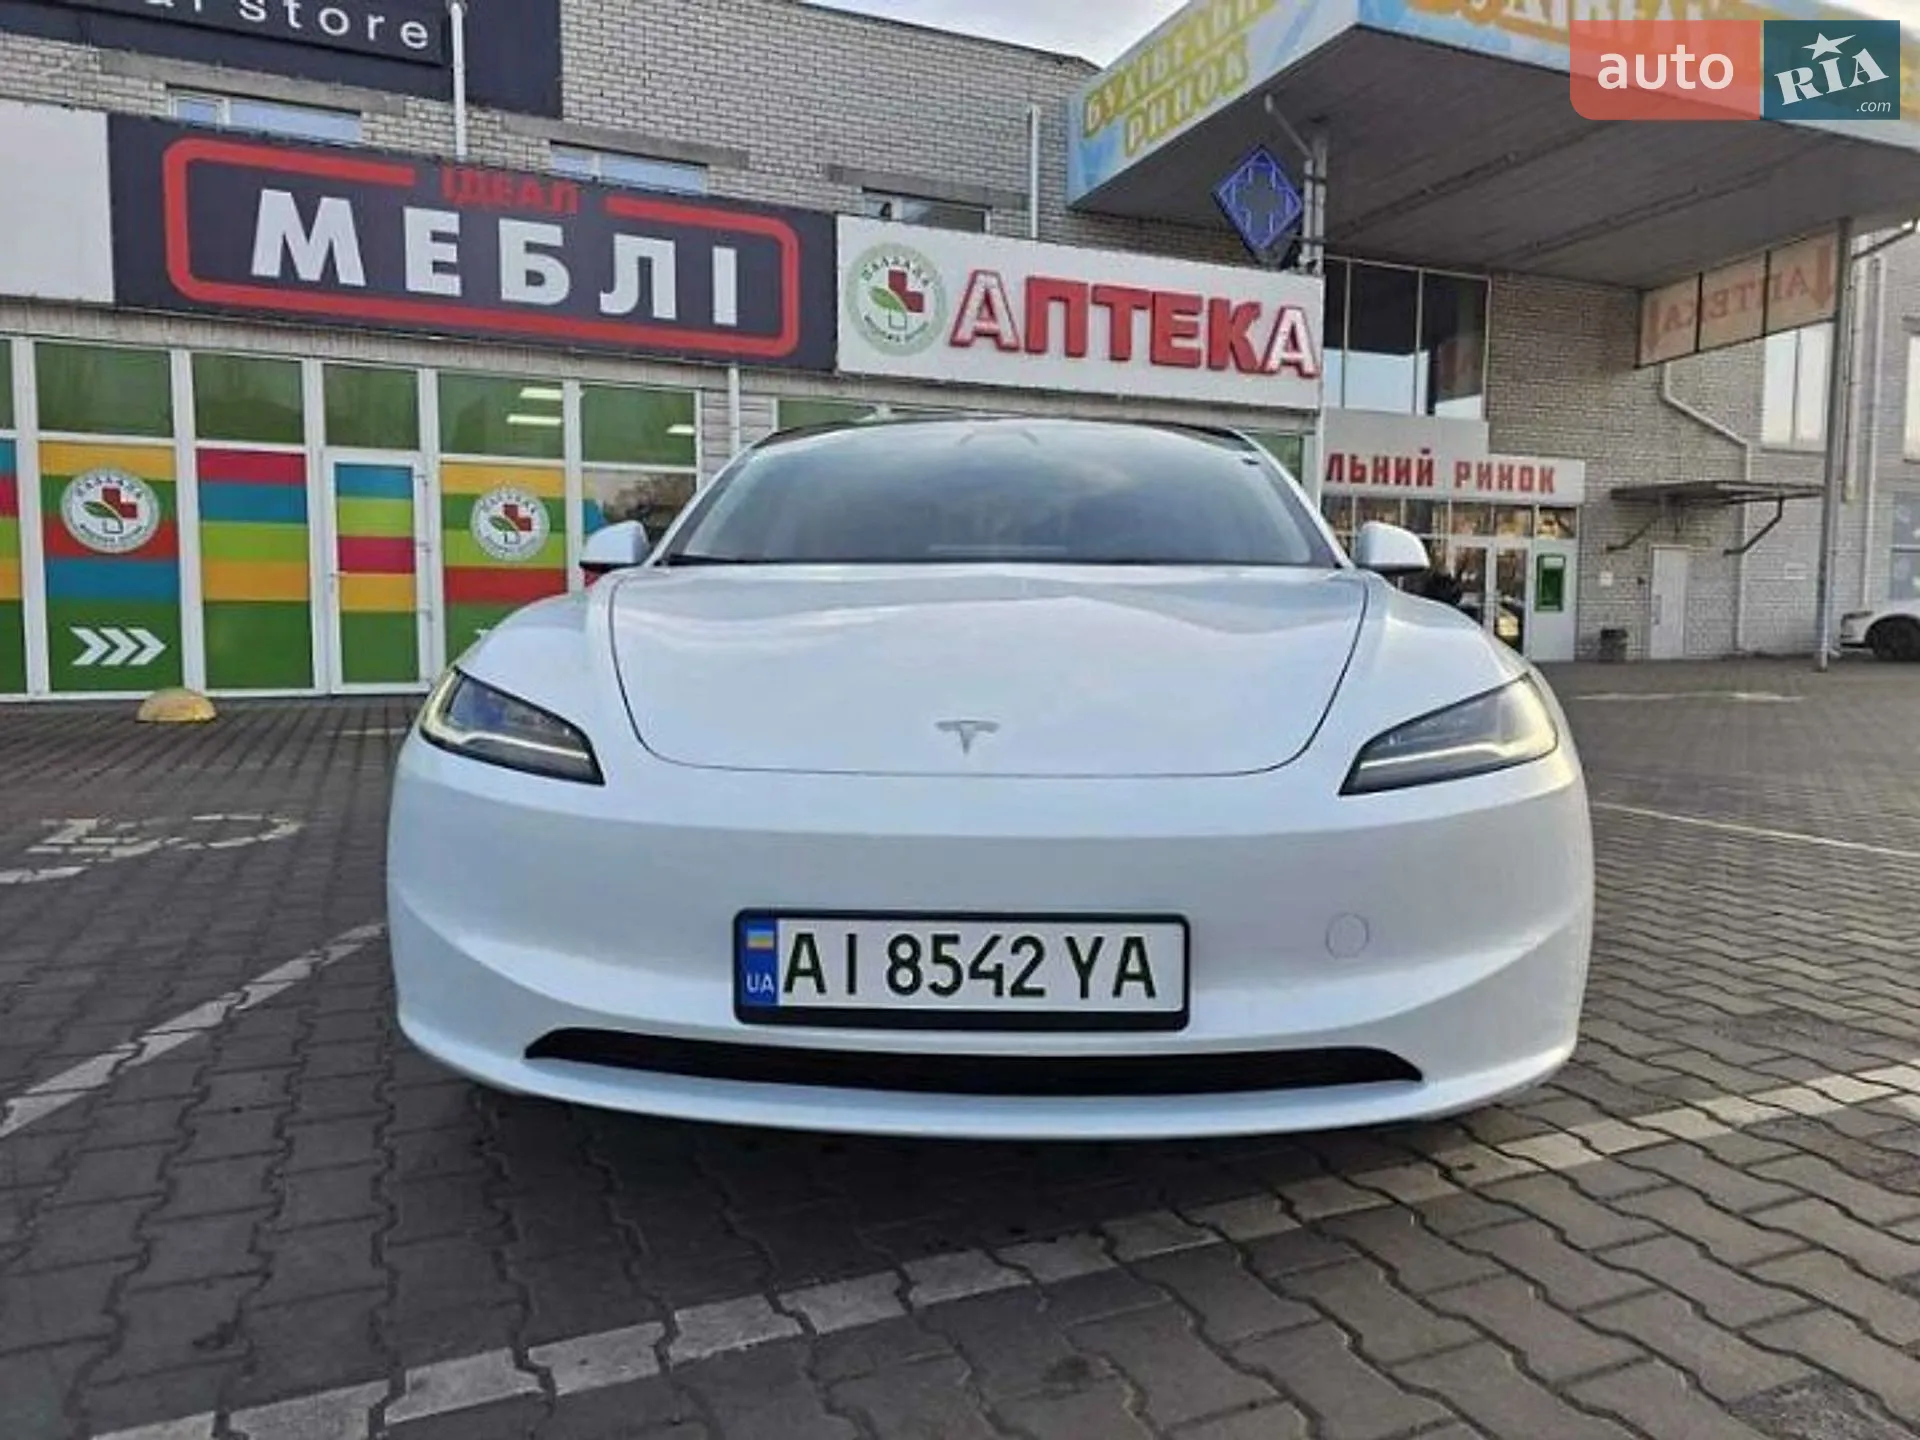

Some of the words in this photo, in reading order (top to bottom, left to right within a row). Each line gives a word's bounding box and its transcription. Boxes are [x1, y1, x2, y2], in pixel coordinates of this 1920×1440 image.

[239, 0, 429, 49] store
[251, 188, 738, 326] МЕБЛІ
[949, 268, 1321, 378] АПТЕКА
[1326, 448, 1434, 488] ЛЬНИЙ
[1454, 460, 1555, 494] РИНОК
[746, 973, 775, 994] UA
[783, 932, 858, 995] AI
[886, 932, 1046, 998] 8542
[1065, 935, 1157, 1000] YA
